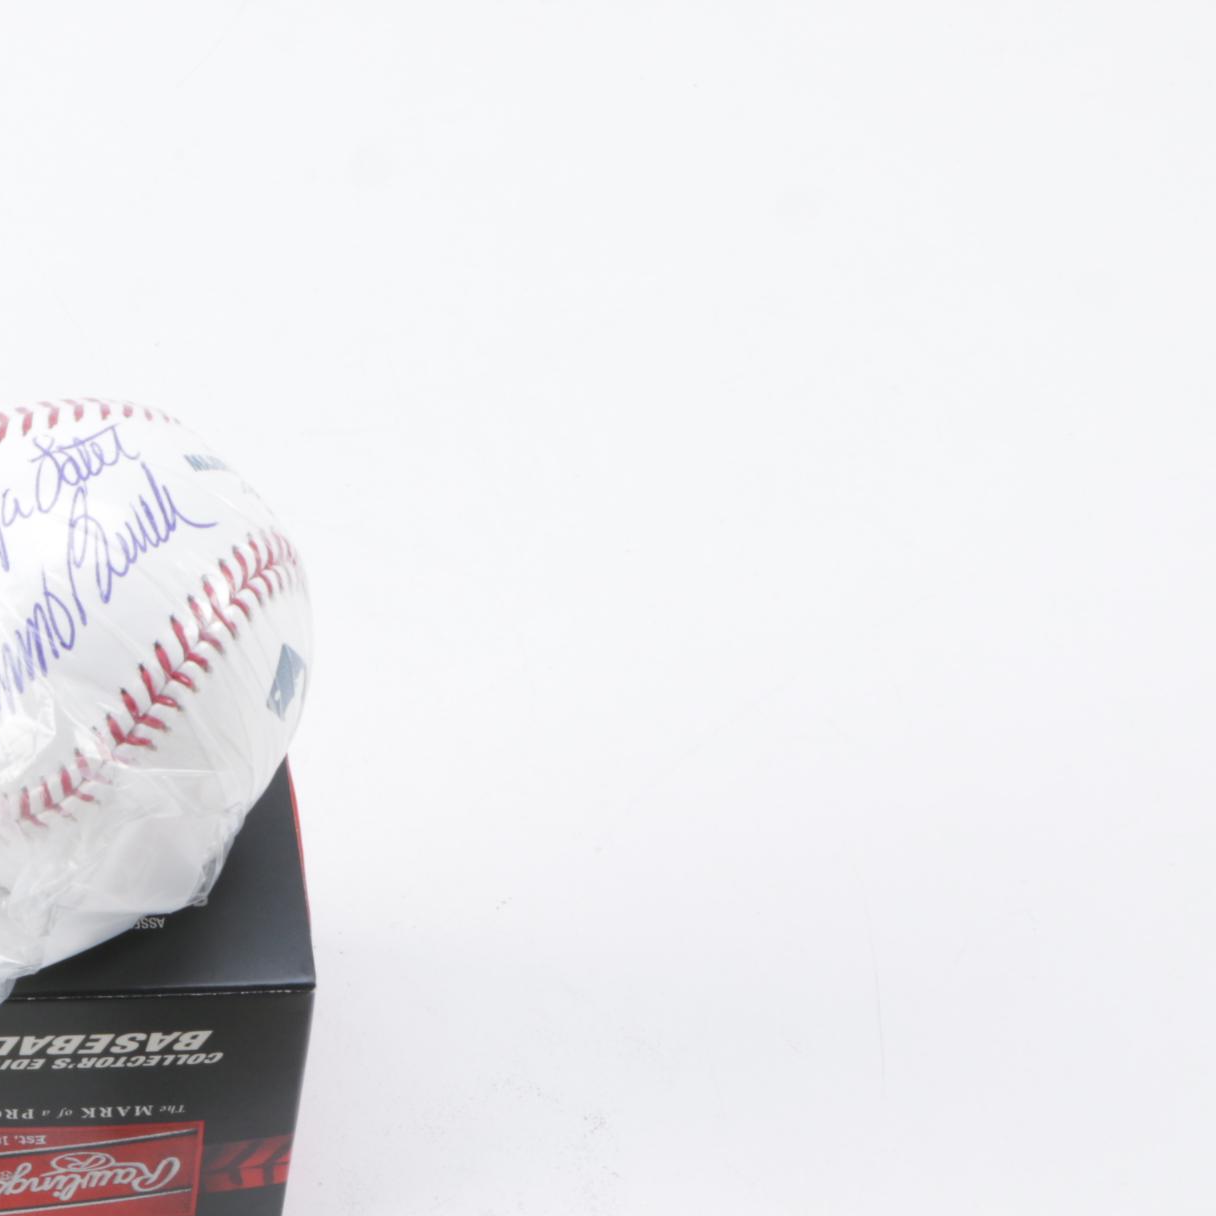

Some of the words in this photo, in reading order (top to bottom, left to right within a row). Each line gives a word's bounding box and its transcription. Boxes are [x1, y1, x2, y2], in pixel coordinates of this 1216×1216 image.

[51, 1052, 224, 1070] COLLECTOR'S
[56, 1107, 73, 1119] of
[81, 1105, 153, 1118] MARK
[159, 1105, 186, 1114] The
[14, 1135, 47, 1146] Est.
